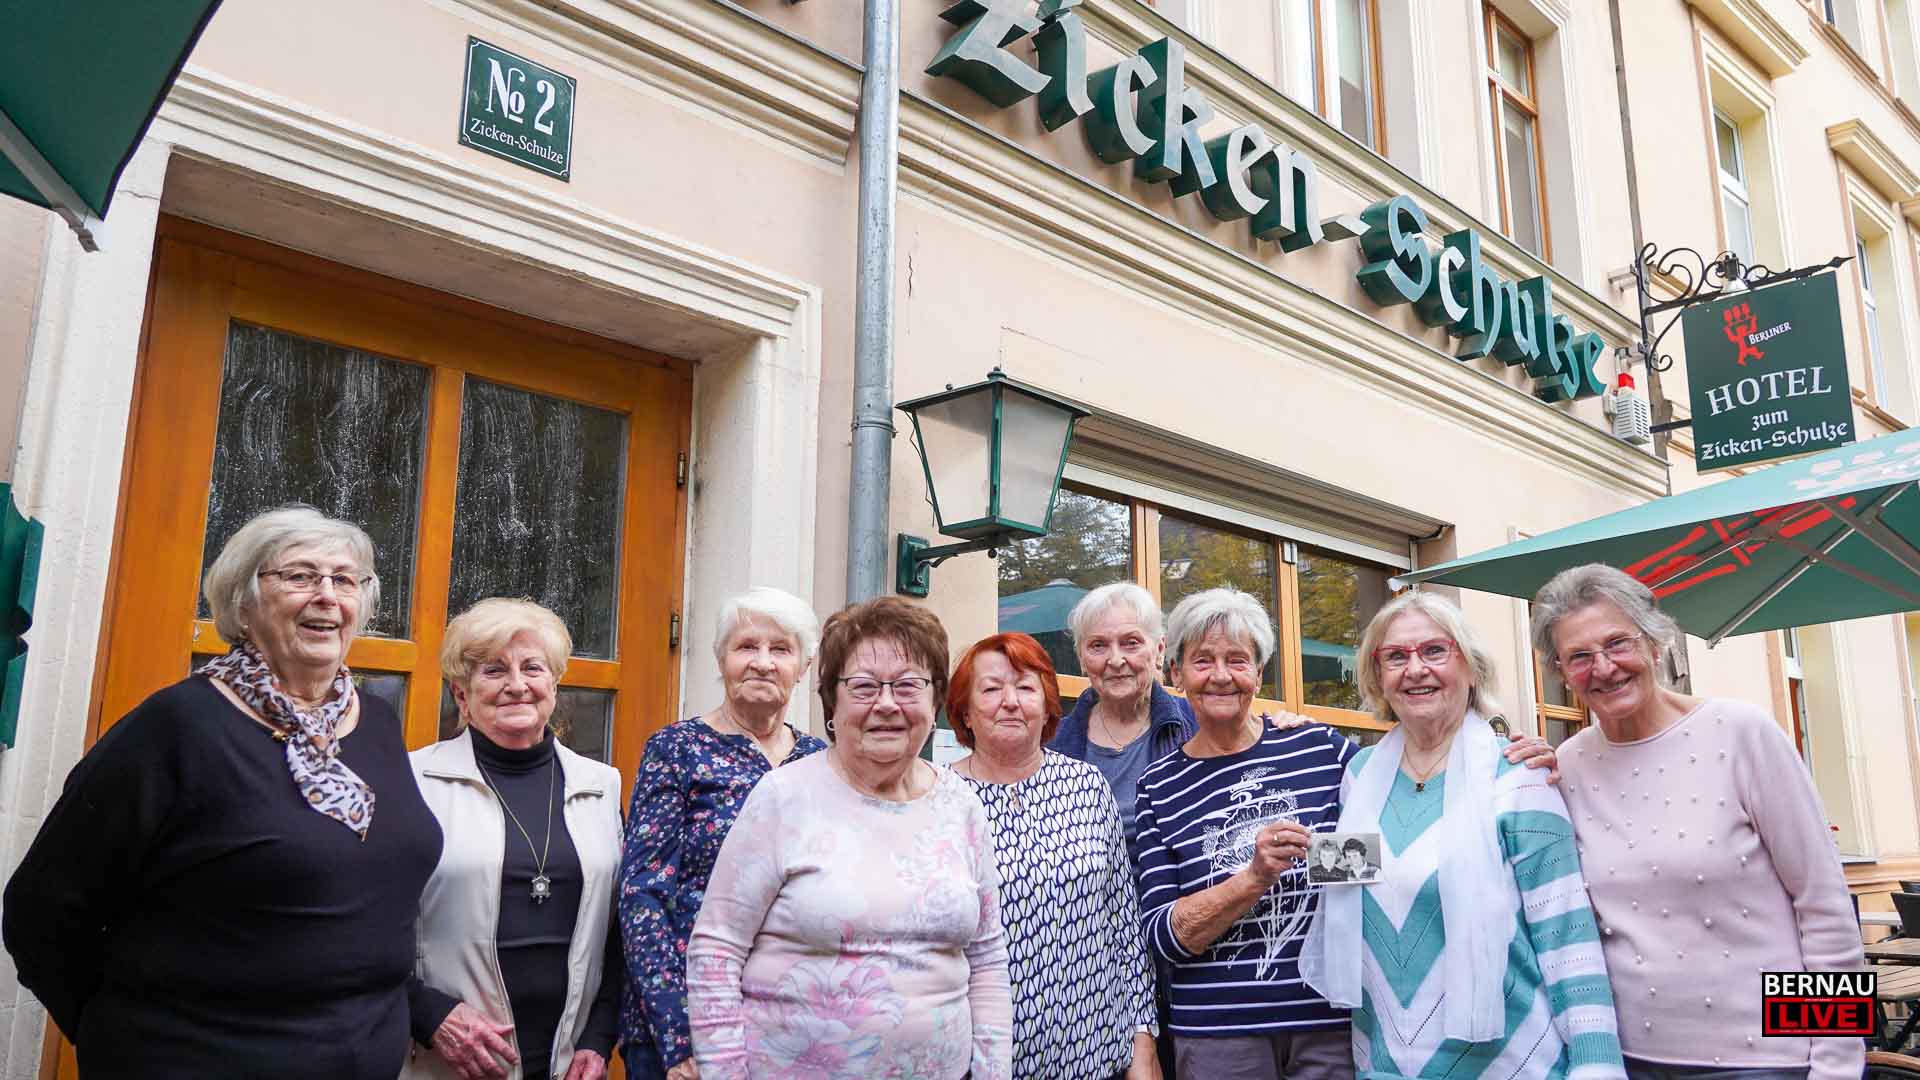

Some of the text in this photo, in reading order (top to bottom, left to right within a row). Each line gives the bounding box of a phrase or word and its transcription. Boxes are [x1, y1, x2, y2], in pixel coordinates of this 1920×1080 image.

[534, 80, 556, 136] 2
[470, 118, 564, 164] Zicken-Schulze
[1749, 322, 1792, 345] BERLINER
[1705, 366, 1832, 416] HOTEL
[1701, 422, 1848, 460] Zicken-Schulze
[1751, 409, 1789, 431] zum
